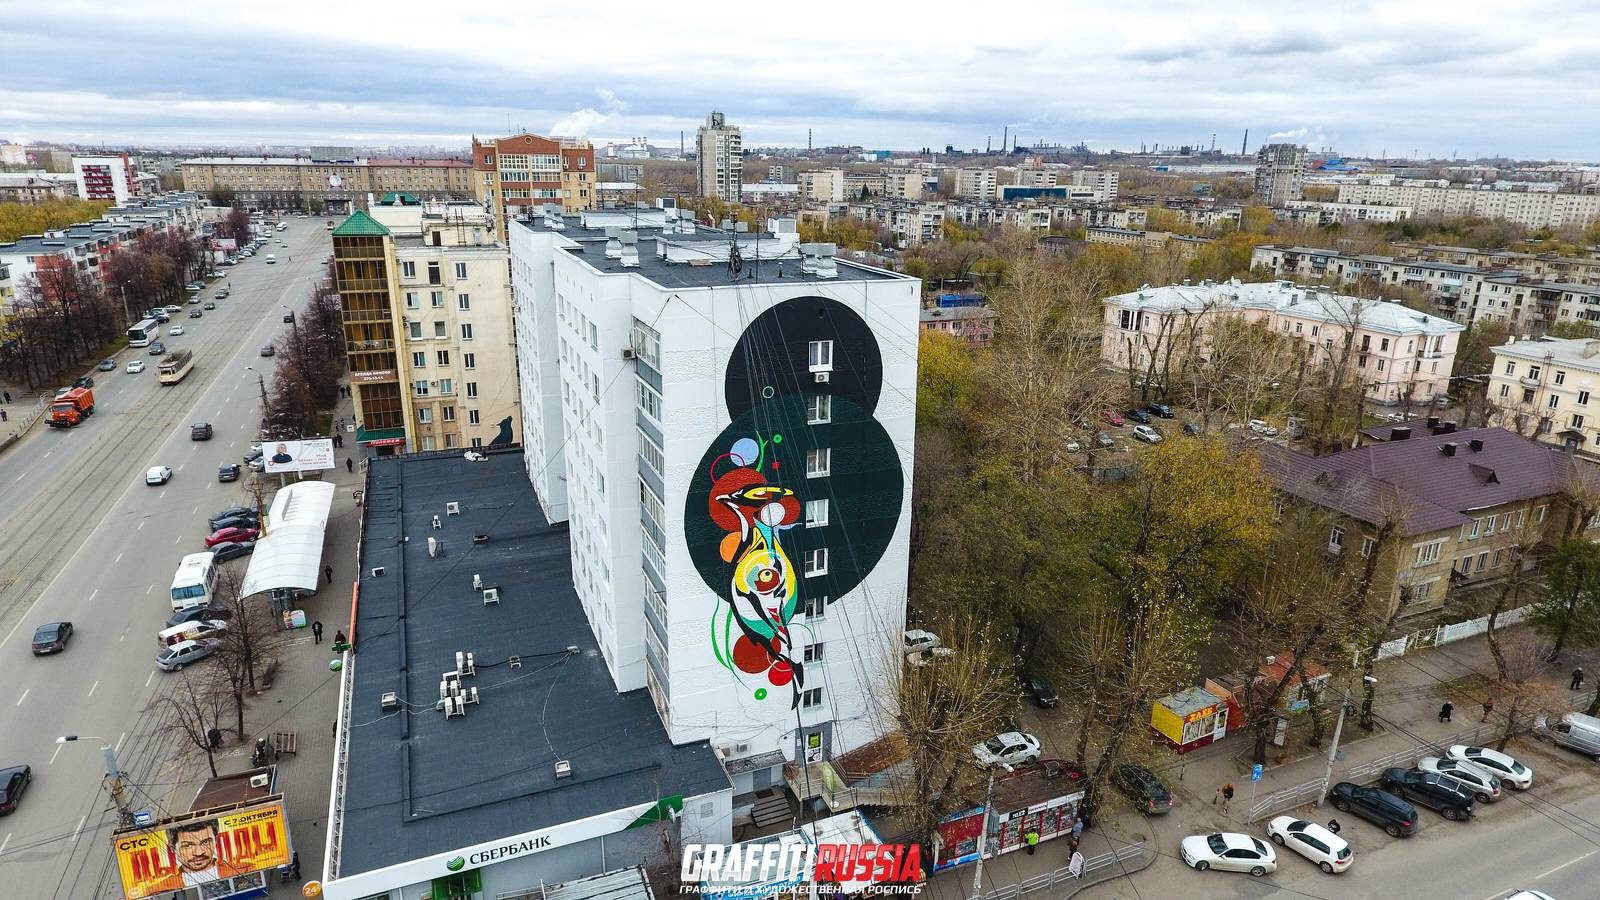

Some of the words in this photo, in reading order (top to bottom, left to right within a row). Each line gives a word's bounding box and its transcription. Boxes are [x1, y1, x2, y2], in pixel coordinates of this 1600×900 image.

[240, 810, 278, 823] ОКТЯБРЯ
[120, 838, 148, 851] СТС
[469, 835, 551, 865] СБЕРБАНК
